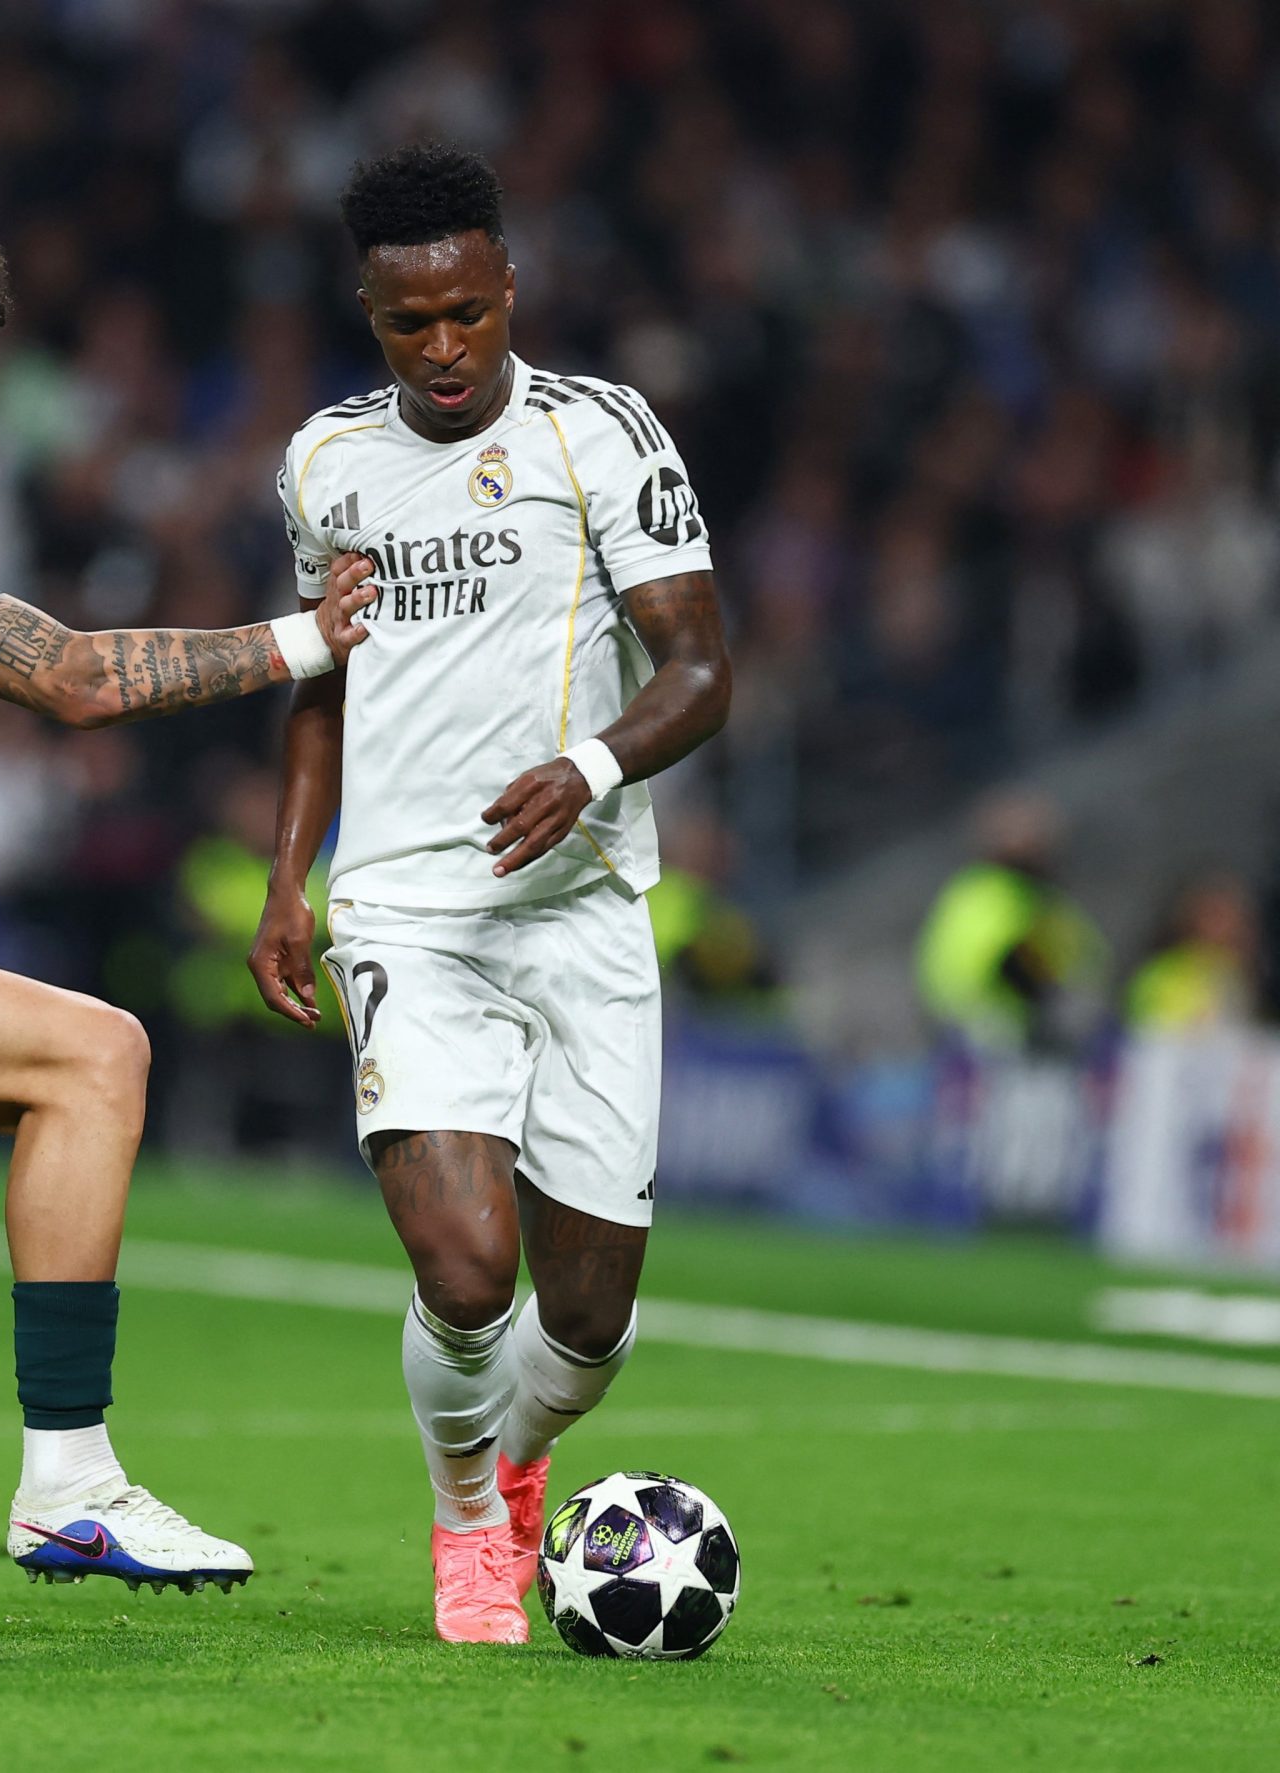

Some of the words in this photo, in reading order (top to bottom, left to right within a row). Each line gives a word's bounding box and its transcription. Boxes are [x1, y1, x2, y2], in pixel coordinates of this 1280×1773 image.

[646, 467, 697, 546] hp
[365, 526, 522, 581] irates
[394, 576, 488, 621] BETTER
[112, 632, 133, 713] verything
[172, 656, 183, 681] WHO
[612, 1521, 636, 1565] CHAMPIONS
[621, 1529, 638, 1560] LEAGUE
